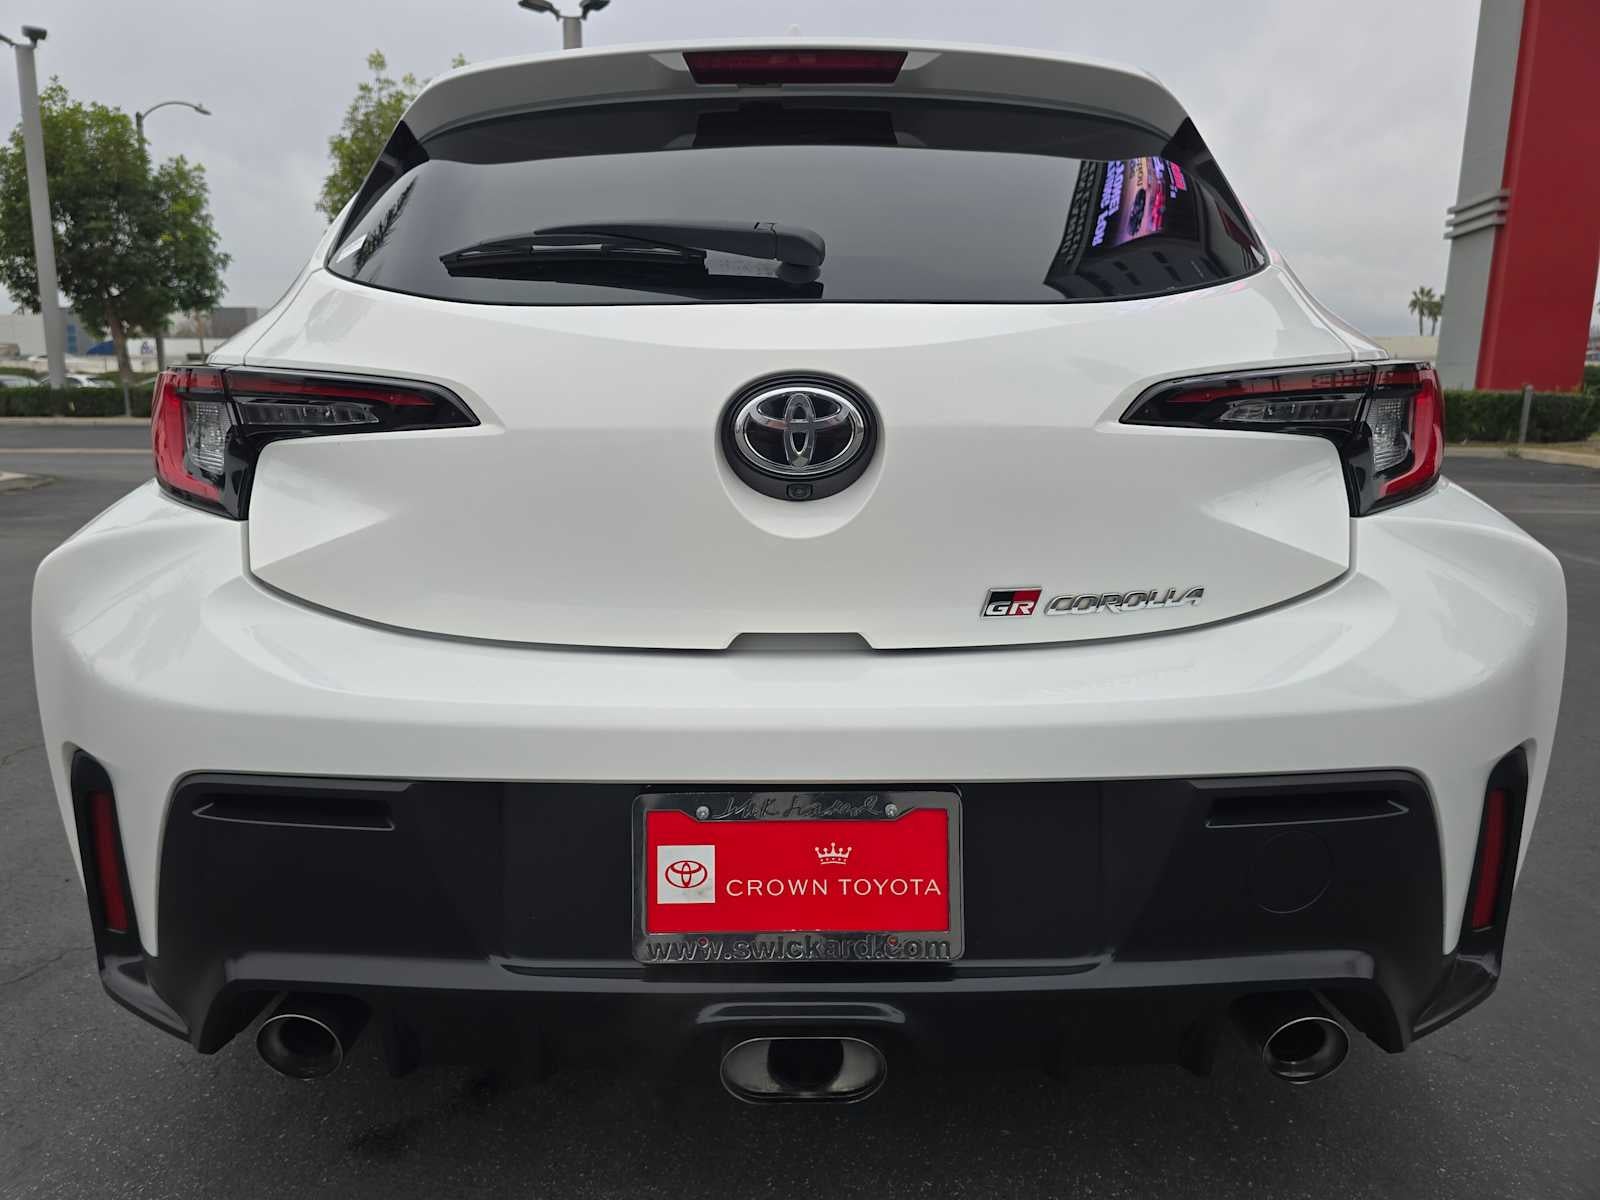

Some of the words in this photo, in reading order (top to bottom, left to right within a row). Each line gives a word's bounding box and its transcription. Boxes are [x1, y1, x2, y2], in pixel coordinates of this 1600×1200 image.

[1045, 586, 1205, 616] COROLLA
[726, 879, 828, 896] CROWN
[838, 878, 941, 896] TOYOTA
[646, 934, 950, 960] www.swickard.com
